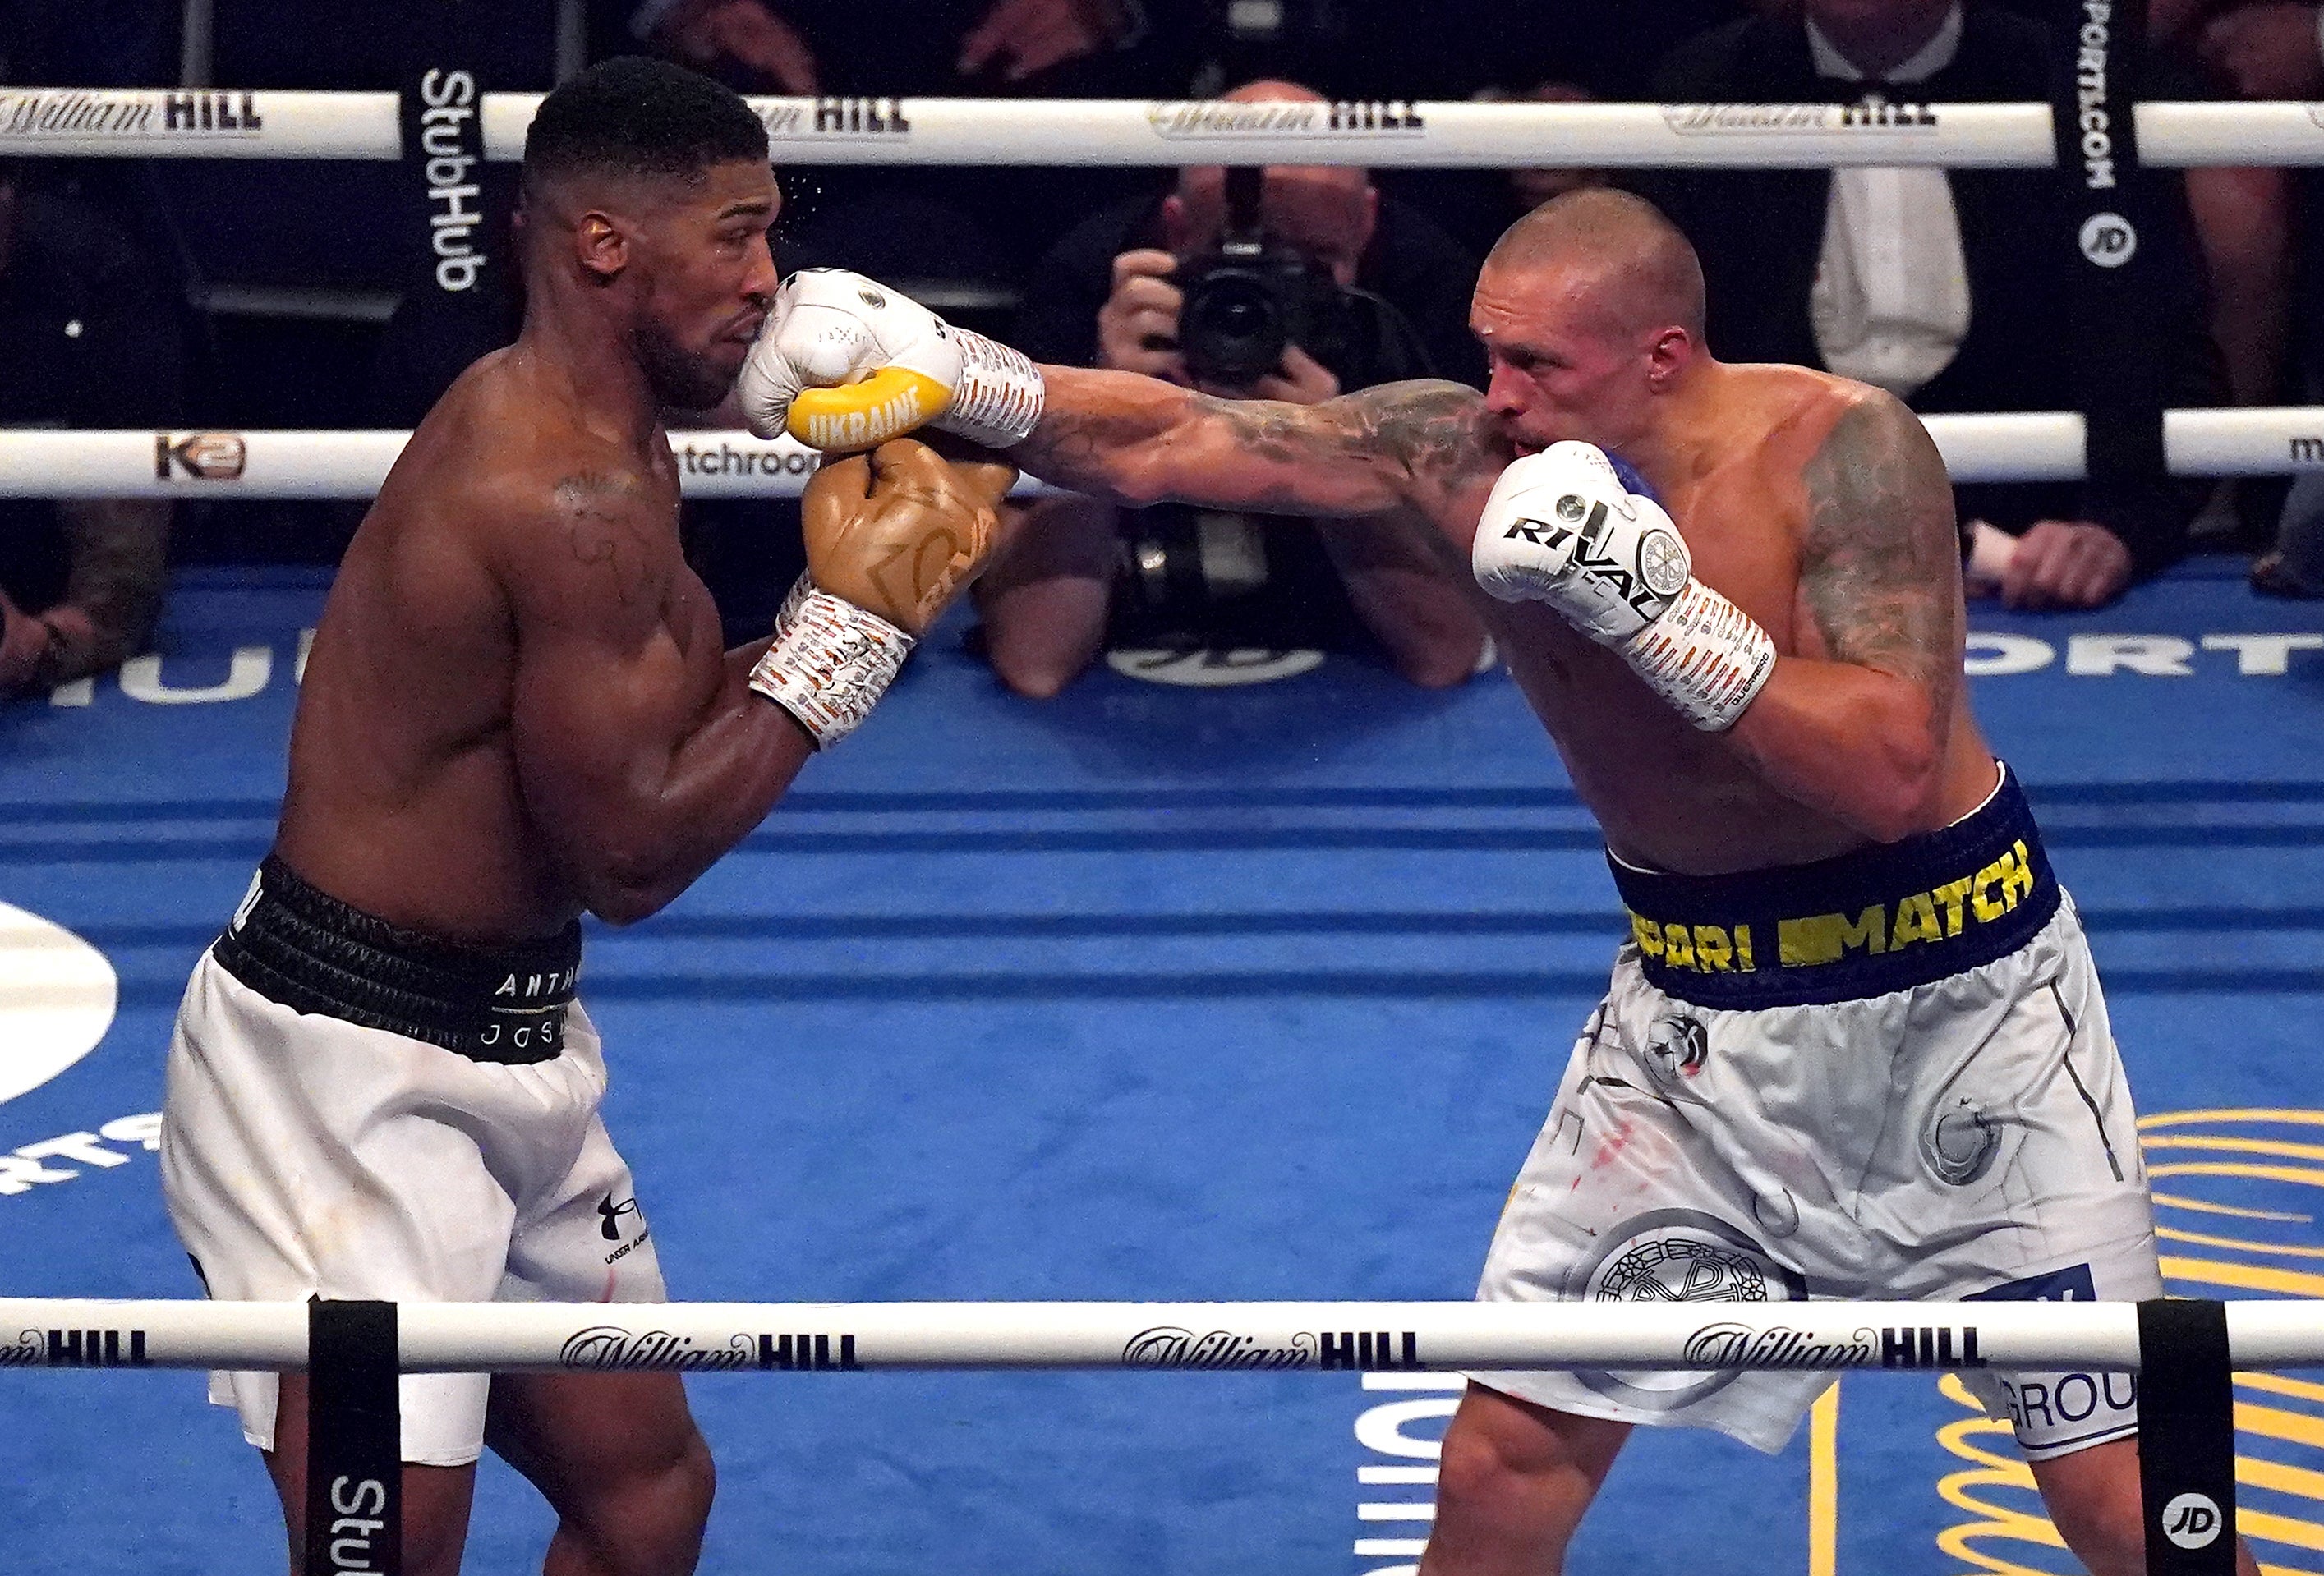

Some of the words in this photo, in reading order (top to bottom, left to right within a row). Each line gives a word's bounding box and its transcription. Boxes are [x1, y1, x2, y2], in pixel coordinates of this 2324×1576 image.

[167, 92, 261, 130] HILL
[814, 97, 909, 133] HILL
[1325, 100, 1424, 131] HILL
[421, 68, 487, 292] StubHub
[808, 385, 922, 450] UKRAINE
[677, 442, 821, 475] tchroo
[1503, 516, 1660, 623] RIVAL
[1631, 910, 1756, 974] PARI
[1825, 838, 2035, 956] MATCH
[495, 967, 574, 998] ANTH
[481, 1015, 565, 1048] JOS
[604, 1243, 632, 1265] UNDER
[48, 1329, 151, 1368] HILL
[559, 1325, 756, 1370] William
[757, 1333, 864, 1370] HILL
[1121, 1326, 1317, 1370] William
[1320, 1331, 1425, 1371] HILL
[1683, 1321, 1878, 1369] William
[1881, 1326, 1987, 1369] HILL
[329, 1475, 386, 1576] Stu
[2170, 1507, 2216, 1535] JD
